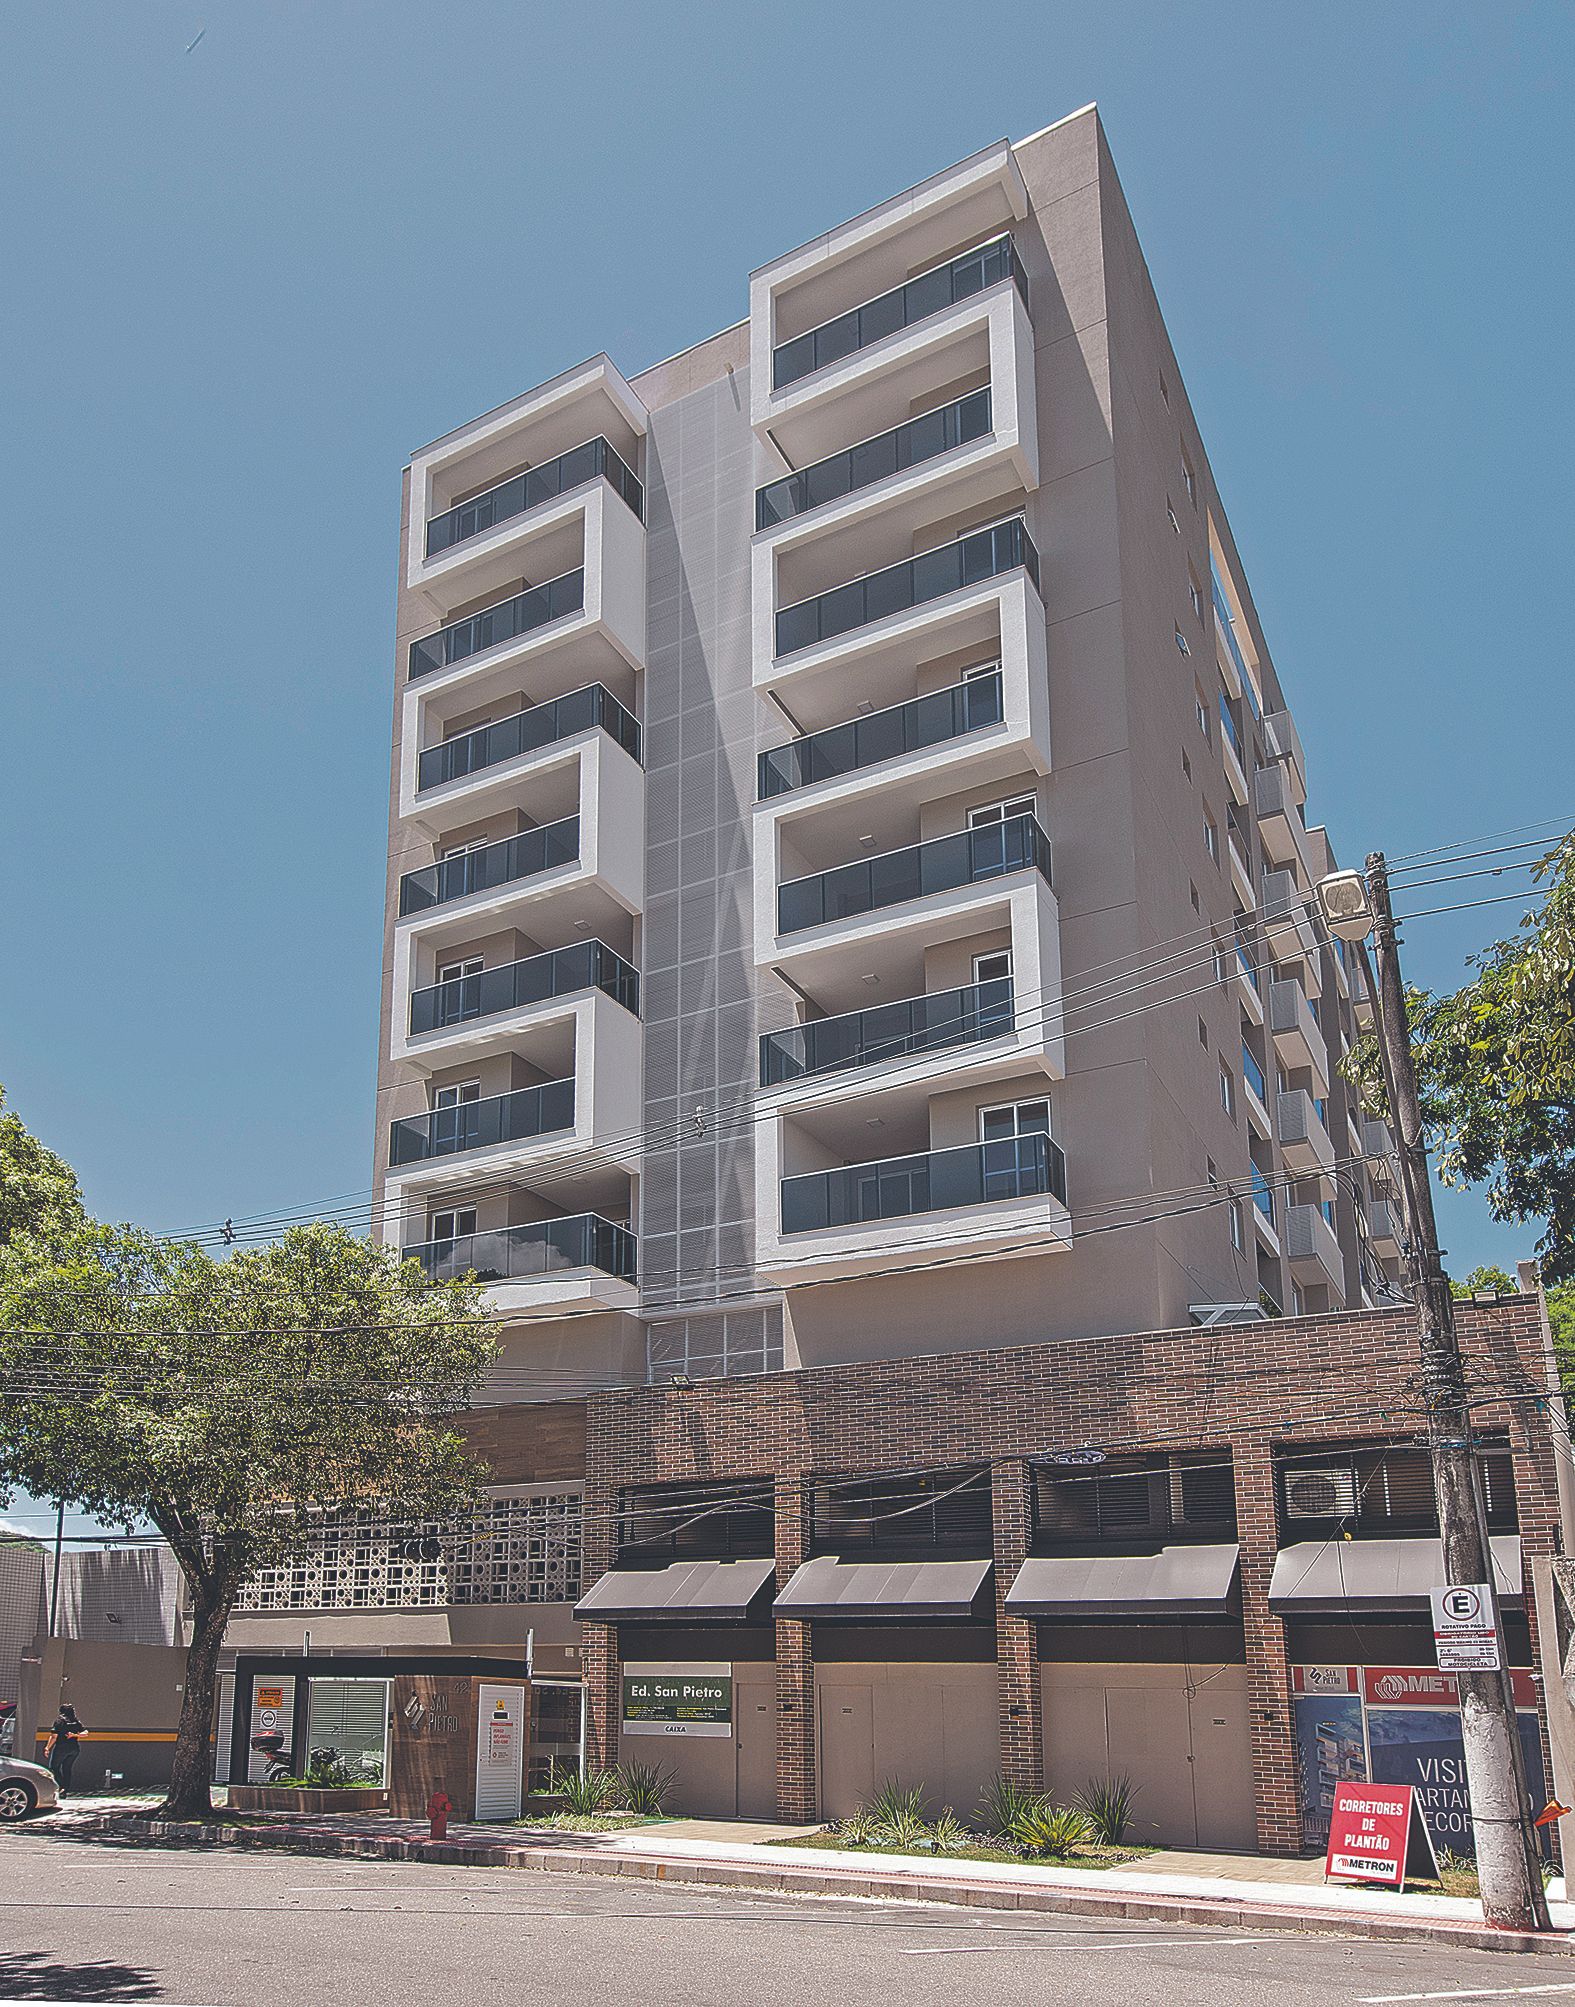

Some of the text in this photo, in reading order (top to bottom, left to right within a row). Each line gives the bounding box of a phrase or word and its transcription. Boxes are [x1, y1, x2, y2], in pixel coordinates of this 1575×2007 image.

[1452, 1595, 1470, 1613] E
[631, 1685, 722, 1698] Ed. San Pietro
[430, 1693, 448, 1711] SAN
[429, 1712, 458, 1732] PIETRO
[665, 1725, 686, 1733] CAIXA
[1416, 1757, 1467, 1783] VISI
[1339, 1798, 1404, 1816] CORRETORES
[1361, 1817, 1376, 1831] DE
[1344, 1833, 1390, 1850] PLANTÃO
[1349, 1858, 1395, 1872] METRON
